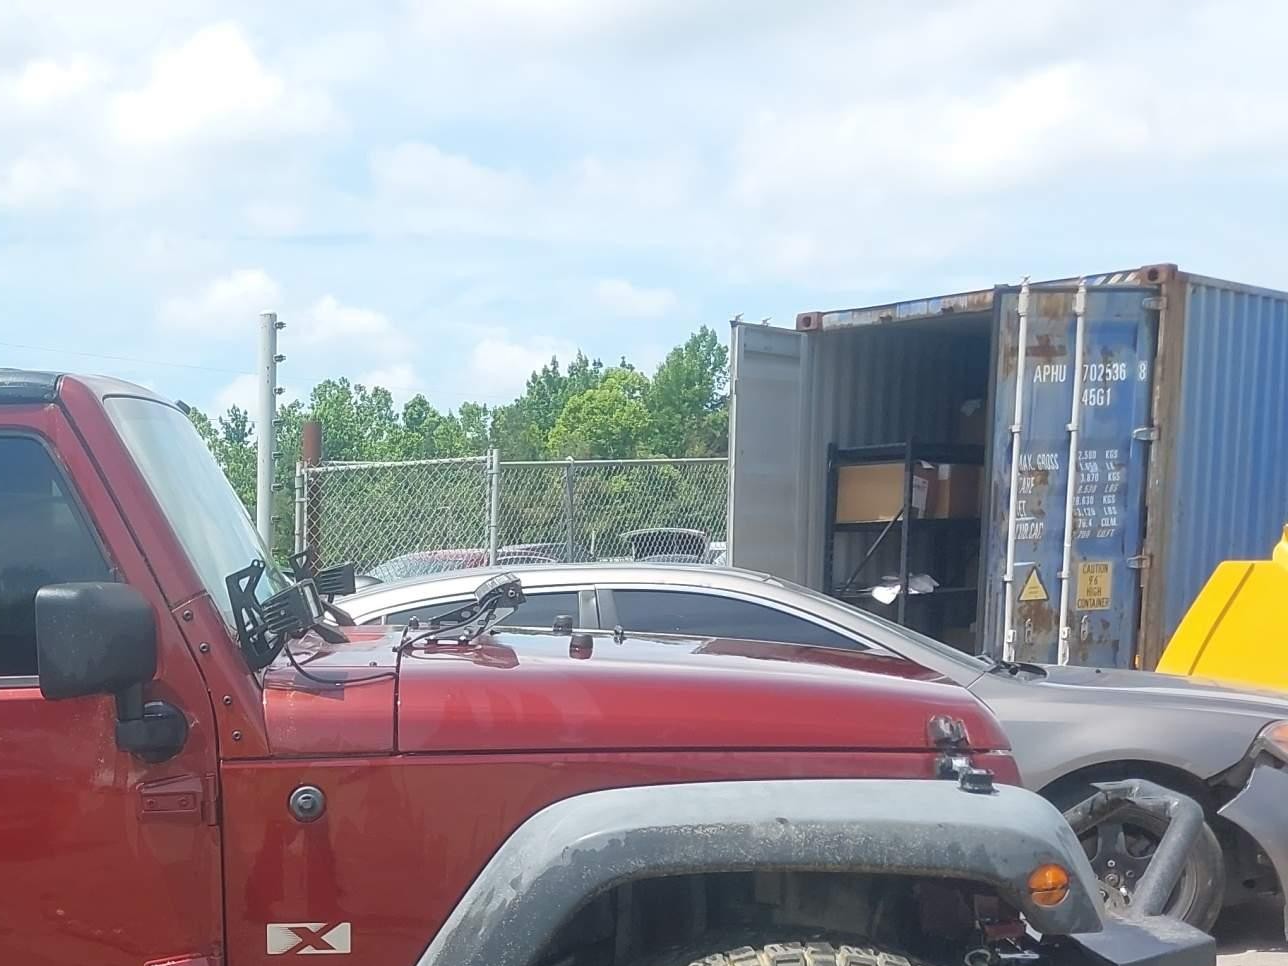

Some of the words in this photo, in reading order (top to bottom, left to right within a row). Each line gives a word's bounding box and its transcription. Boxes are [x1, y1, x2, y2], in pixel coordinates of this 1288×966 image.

[1033, 364, 1067, 383] APHU
[1082, 363, 1127, 382] 702536
[1138, 361, 1148, 380] 8
[1082, 388, 1112, 407] 45G1
[1105, 449, 1119, 459] KGS
[1037, 453, 1059, 470] GROSS
[1107, 472, 1120, 482] KGS
[1102, 494, 1116, 504] KGS
[1082, 564, 1109, 574] CAUTION
[1086, 586, 1102, 598] HIGH
